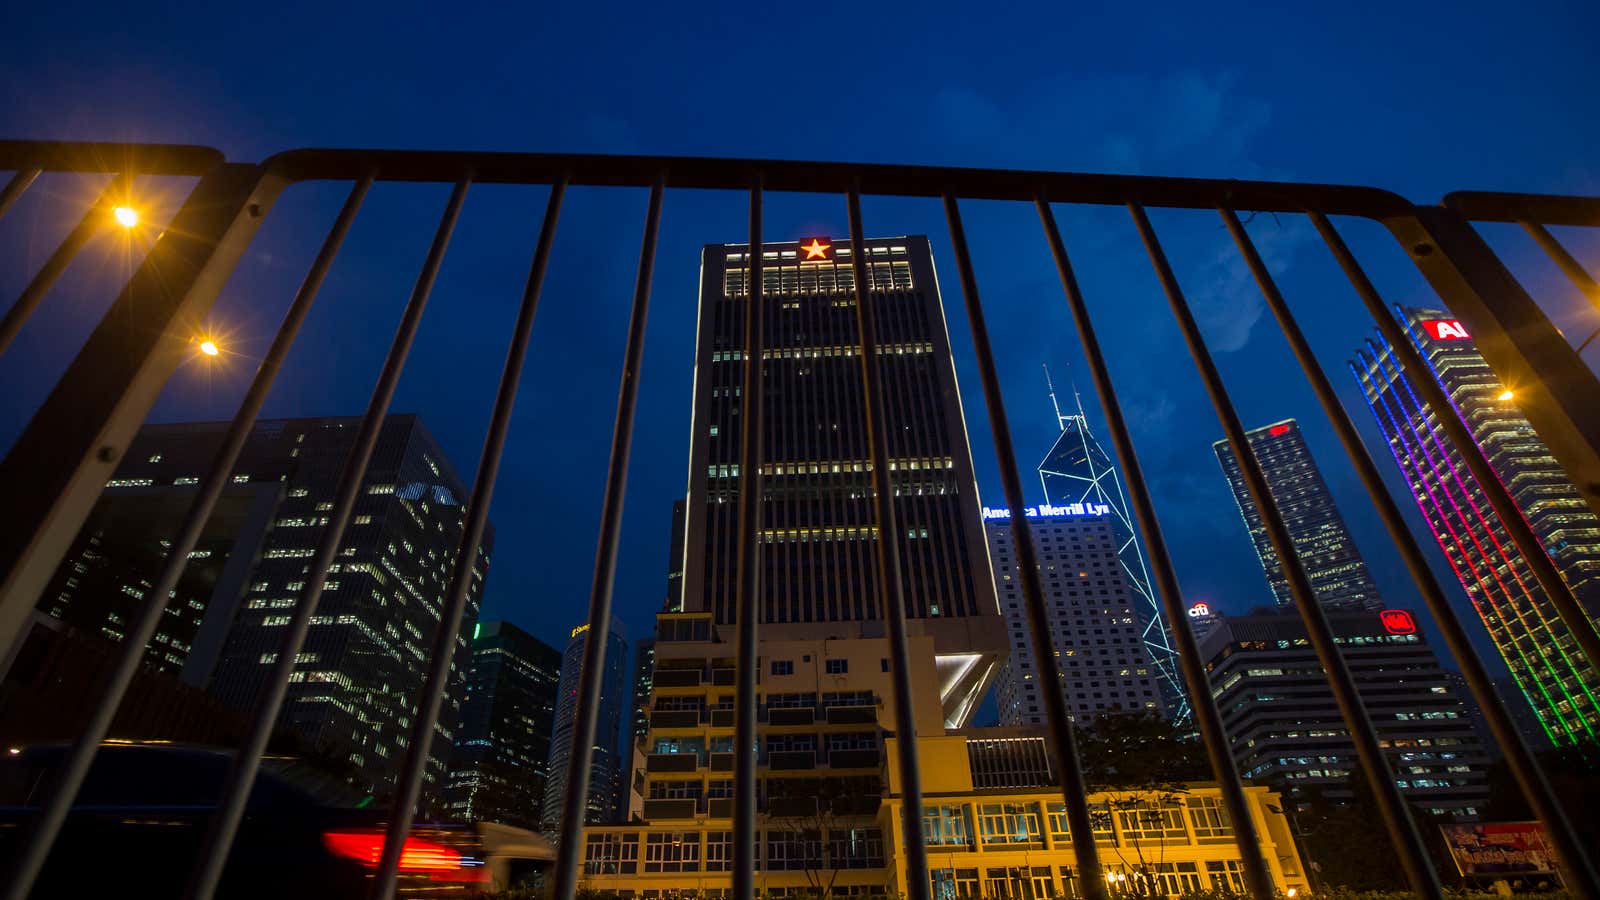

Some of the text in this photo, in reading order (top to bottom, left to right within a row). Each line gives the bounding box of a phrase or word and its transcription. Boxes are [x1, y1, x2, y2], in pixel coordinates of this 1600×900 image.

[983, 507, 1037, 518] Ameca
[1039, 503, 1085, 516] Merrill
[1188, 604, 1209, 615] citi
